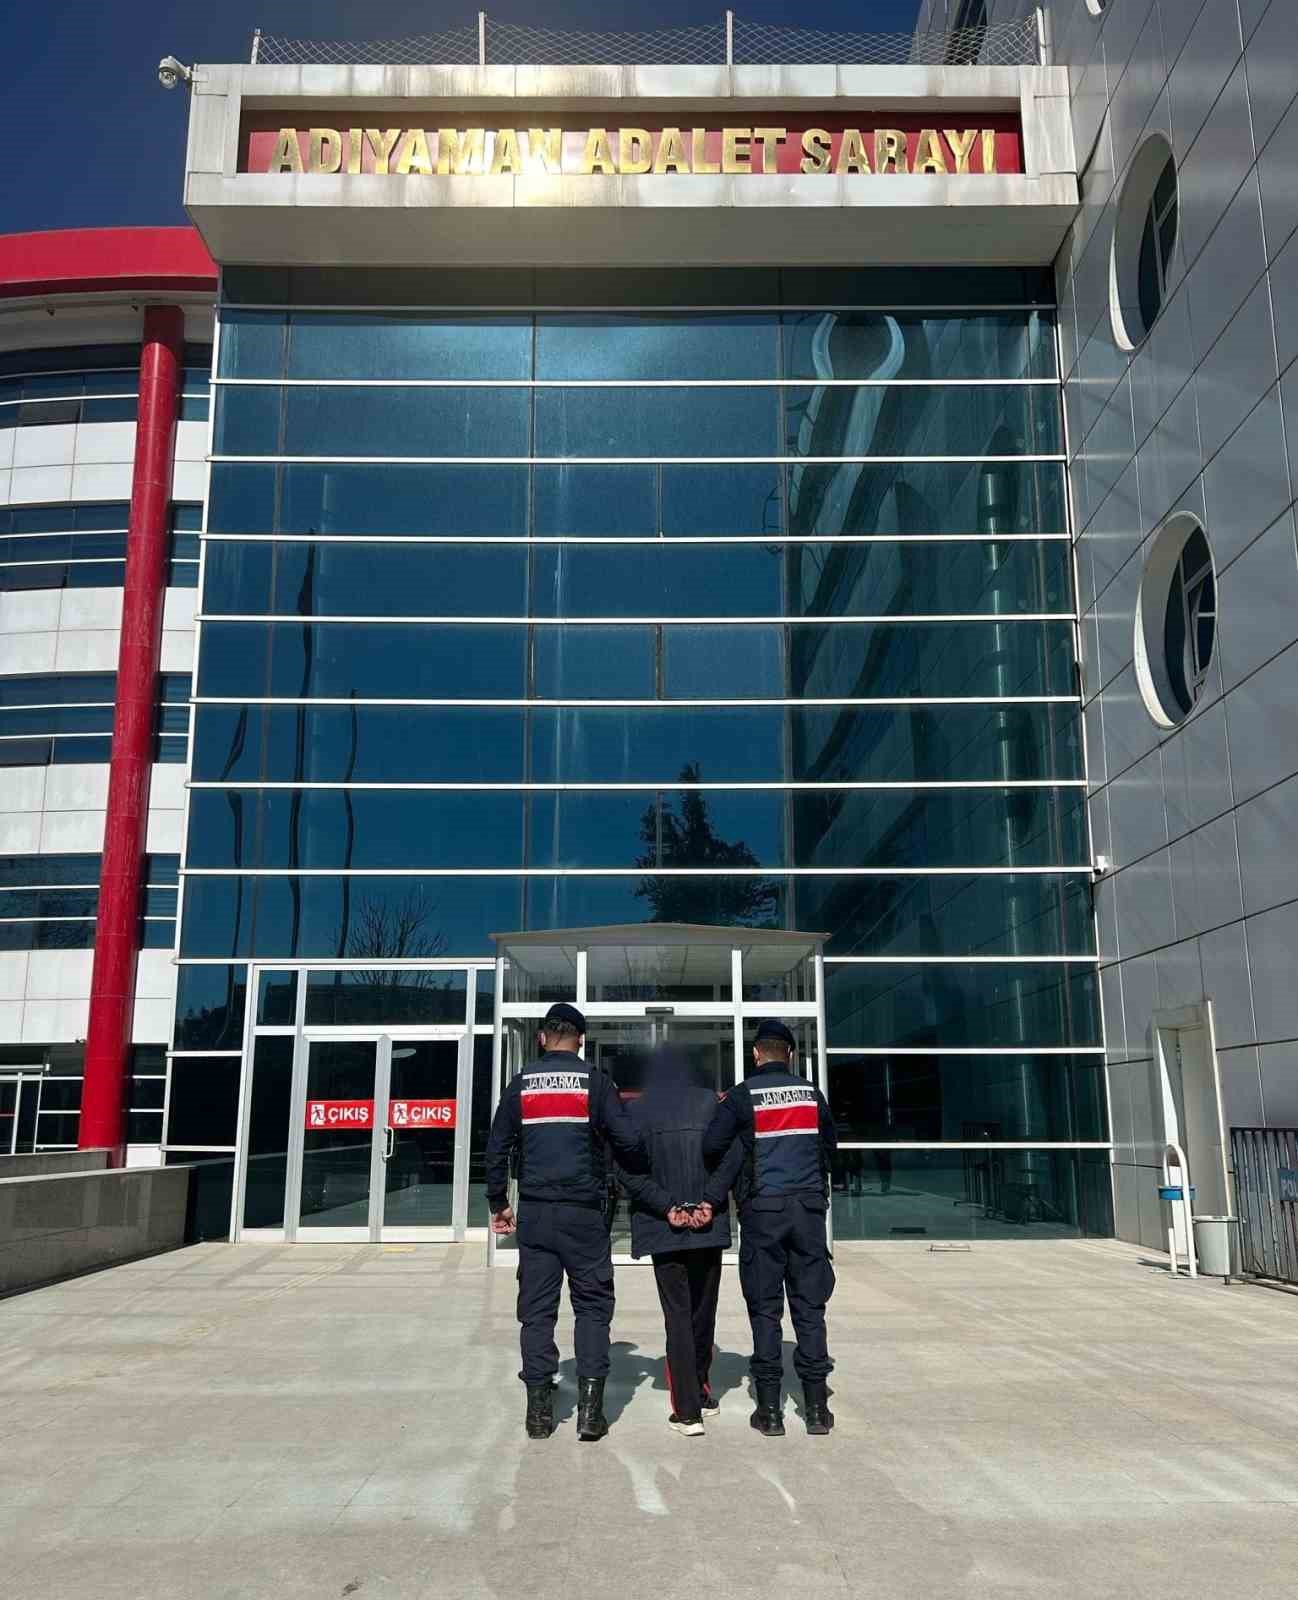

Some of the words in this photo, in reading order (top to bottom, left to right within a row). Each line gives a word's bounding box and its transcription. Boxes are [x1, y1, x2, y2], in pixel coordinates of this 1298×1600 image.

[271, 128, 563, 175] ADIYAMAN
[581, 128, 786, 174] ADALET
[801, 128, 998, 174] SARAYI
[526, 1075, 581, 1089] JANDARMA
[760, 1089, 812, 1105] JANDARMA
[328, 1107, 369, 1123] ÇIKIŞ
[410, 1106, 452, 1122] ÇIKIŞ
